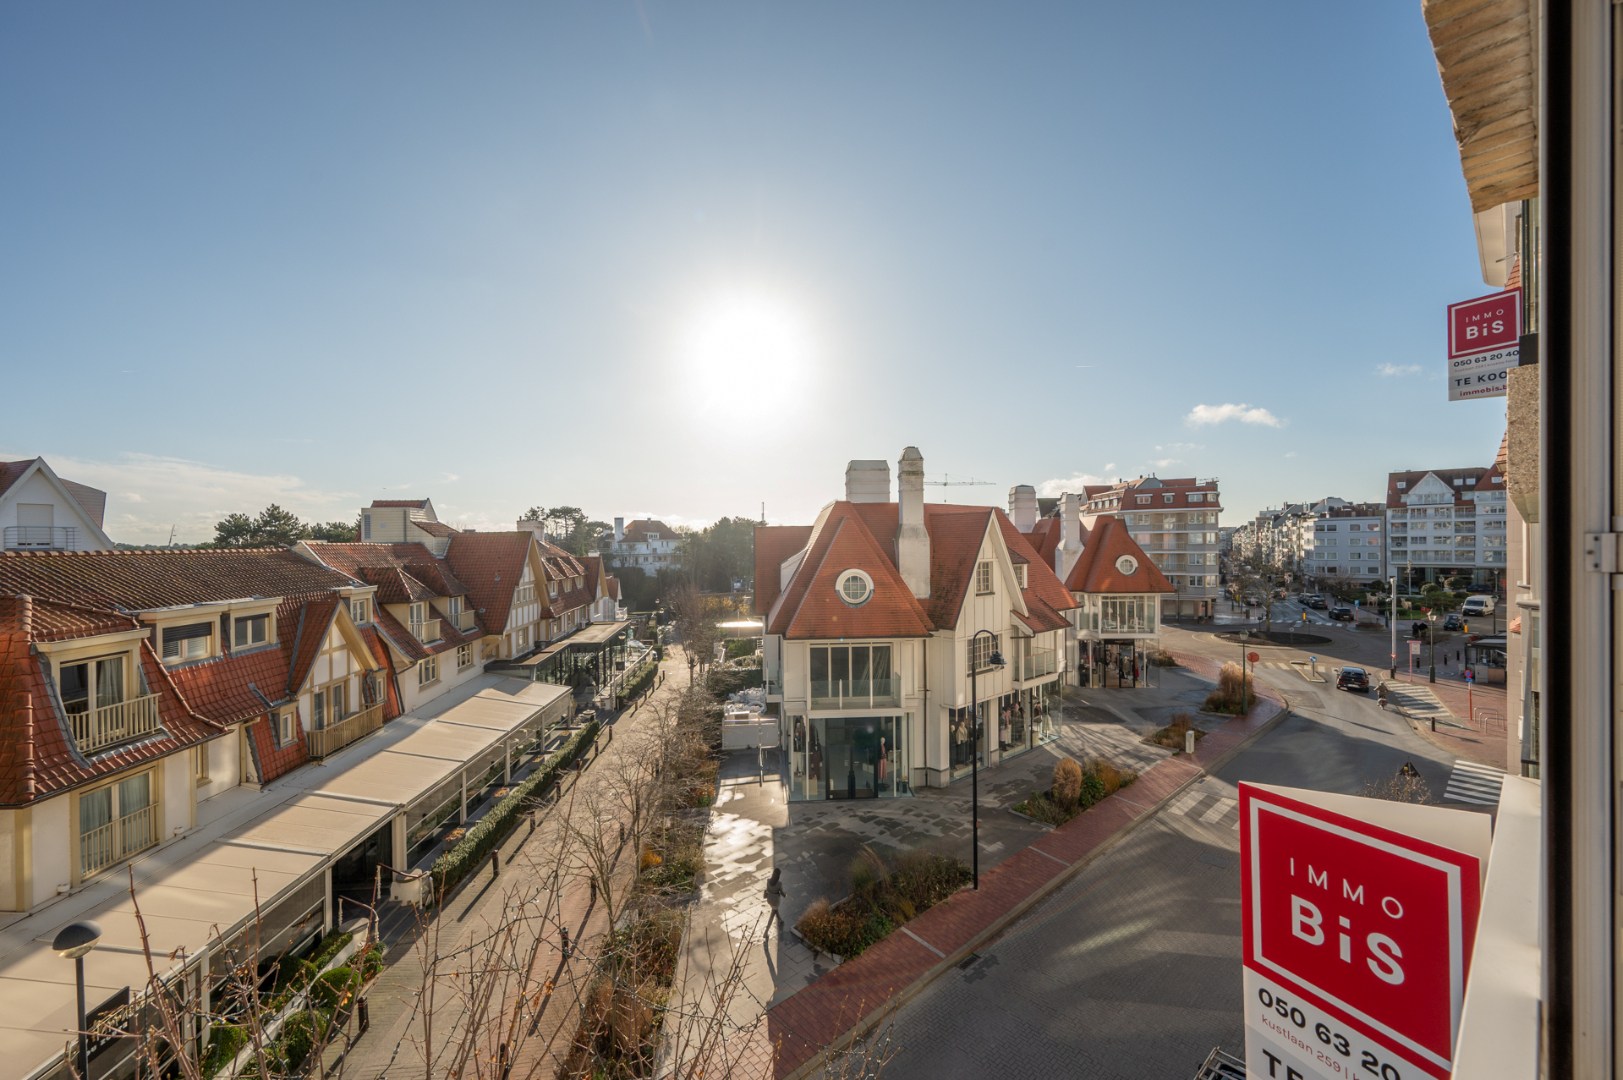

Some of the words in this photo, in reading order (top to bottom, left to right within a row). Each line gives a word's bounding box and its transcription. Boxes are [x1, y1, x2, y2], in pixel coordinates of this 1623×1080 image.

[1466, 309, 1504, 322] IMMO
[1466, 320, 1504, 340] BiS
[1453, 359, 1472, 368] 050
[1474, 356, 1487, 364] 63
[1490, 353, 1503, 361] 20
[1455, 377, 1471, 387] TE
[1477, 371, 1507, 383] KOO
[1460, 384, 1507, 397] immobis.b
[1290, 857, 1404, 919] IMMO
[1291, 893, 1405, 986] BiS
[1258, 987, 1306, 1029] 050
[1315, 1022, 1351, 1057] 63
[1361, 1050, 1401, 1080] 20
[1261, 1014, 1313, 1055] kustlaan
[1316, 1051, 1341, 1073] 259
